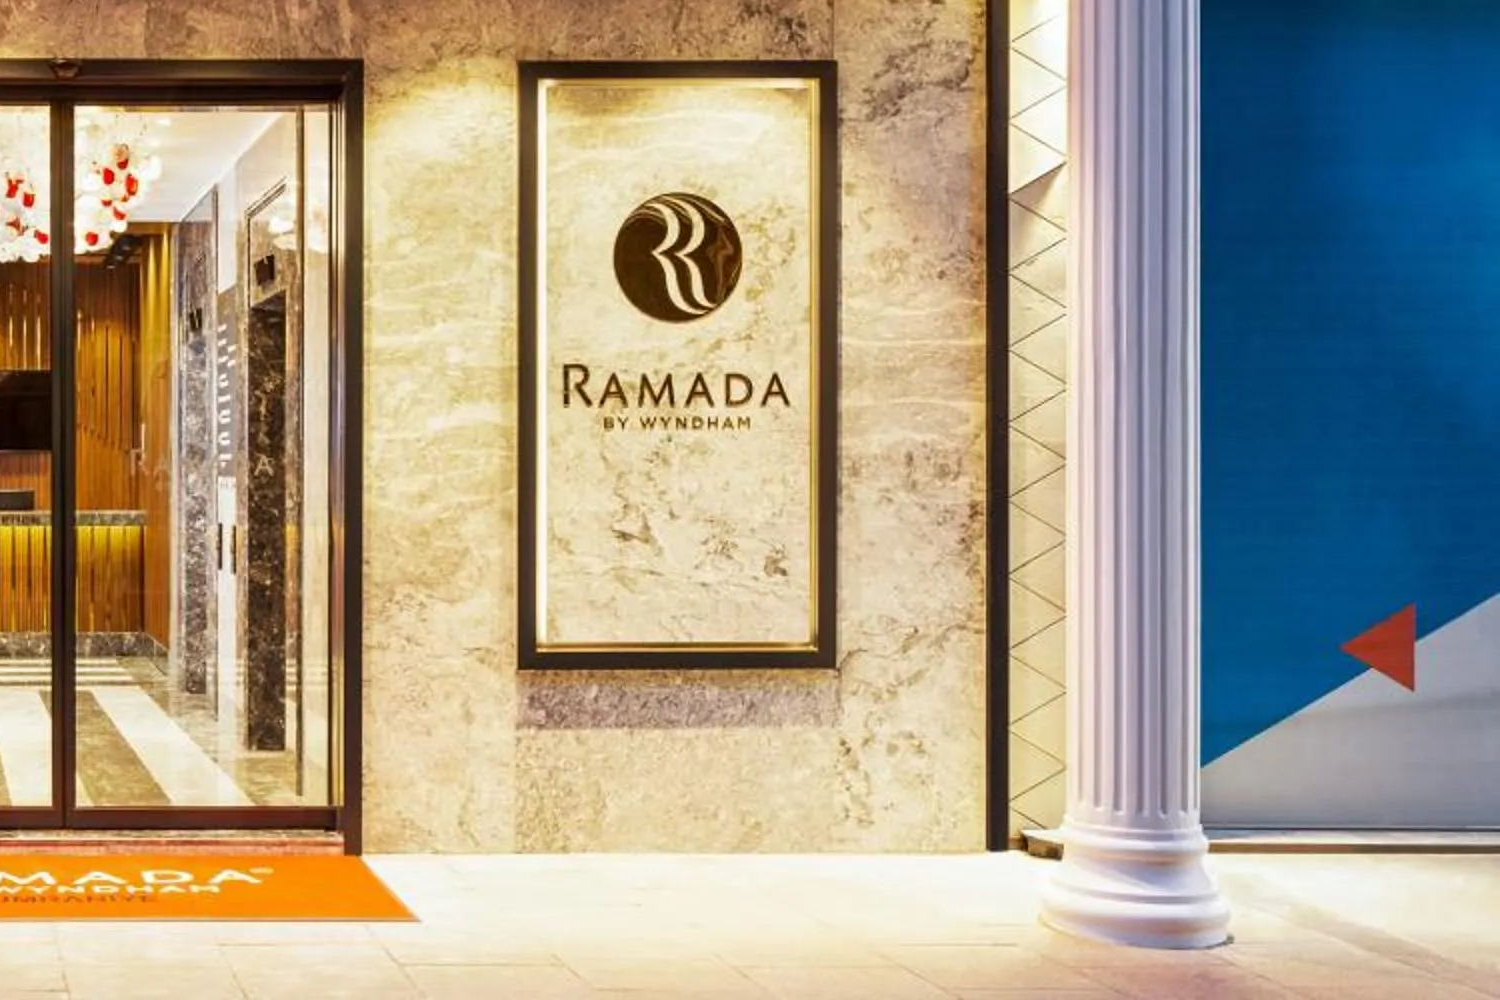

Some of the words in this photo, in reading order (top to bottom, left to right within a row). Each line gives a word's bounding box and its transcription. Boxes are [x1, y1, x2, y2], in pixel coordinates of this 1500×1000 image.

[562, 363, 791, 408] RAMADA
[603, 416, 629, 432] BY
[640, 416, 752, 431] WYNDHAM
